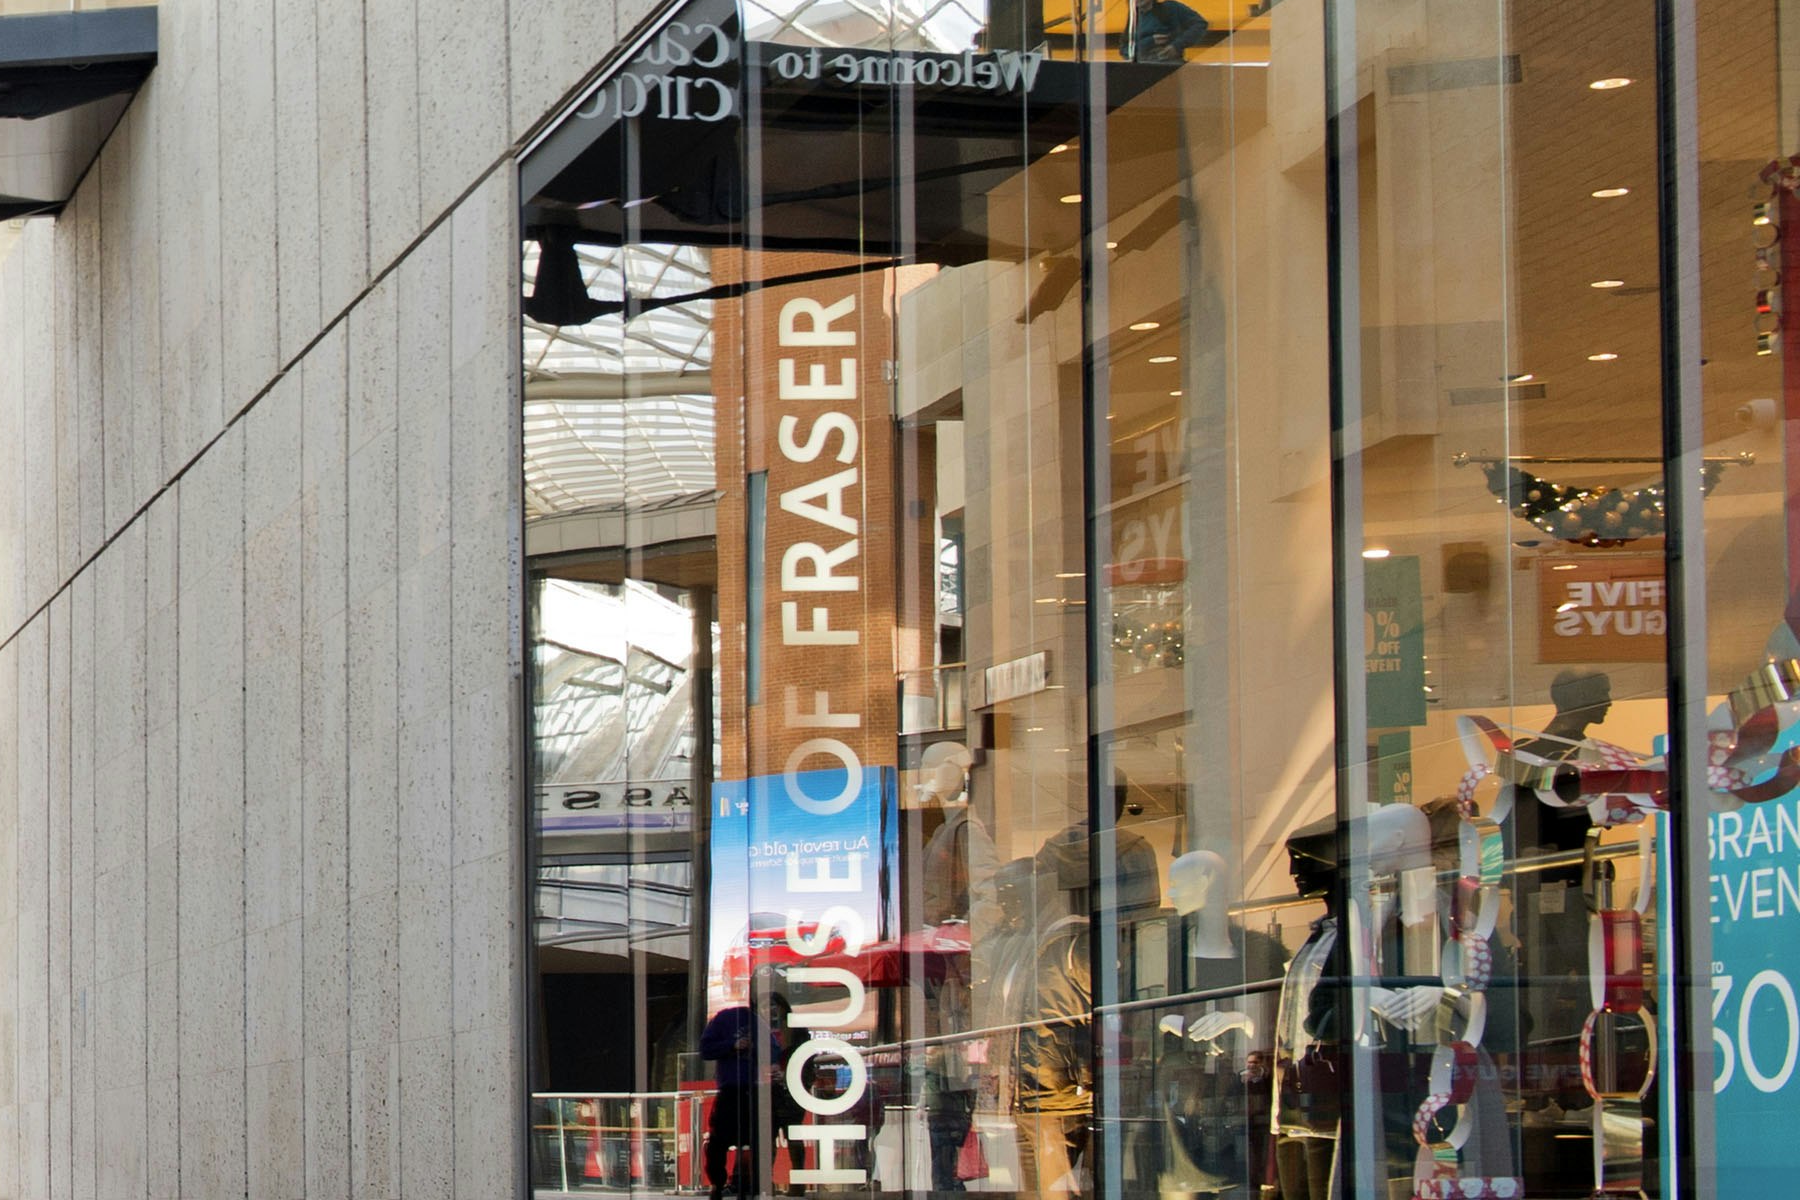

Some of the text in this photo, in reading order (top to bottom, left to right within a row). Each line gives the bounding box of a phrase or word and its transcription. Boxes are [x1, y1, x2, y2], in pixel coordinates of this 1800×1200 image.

[778, 293, 860, 645] FRASER
[783, 685, 863, 815] OF
[786, 851, 867, 1186] HOUSE
